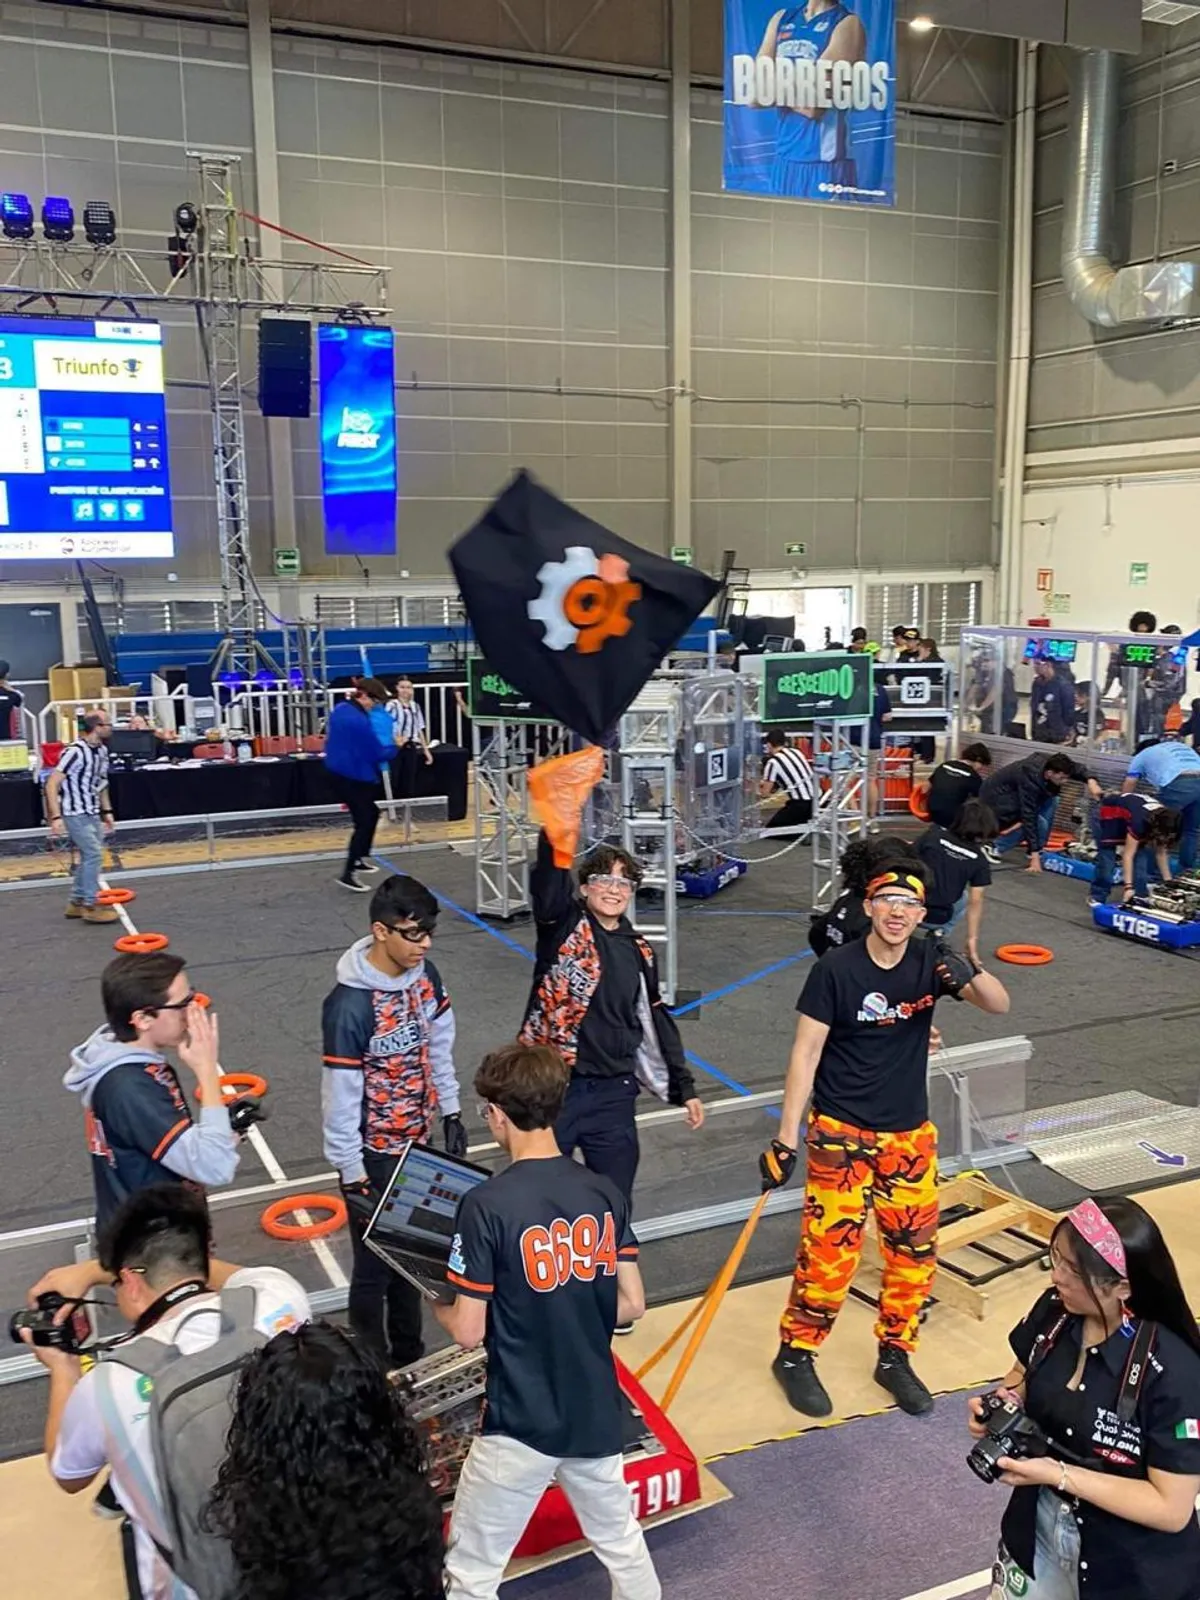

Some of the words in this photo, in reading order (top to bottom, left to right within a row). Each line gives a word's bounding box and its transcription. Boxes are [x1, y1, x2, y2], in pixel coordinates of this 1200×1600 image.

[733, 54, 889, 112] BORREGOS
[52, 357, 119, 376] Triunfo
[777, 664, 854, 700] CRESCENDO
[1112, 913, 1160, 942] 4782
[520, 1212, 618, 1293] 6694
[1128, 1363, 1141, 1386] EOS
